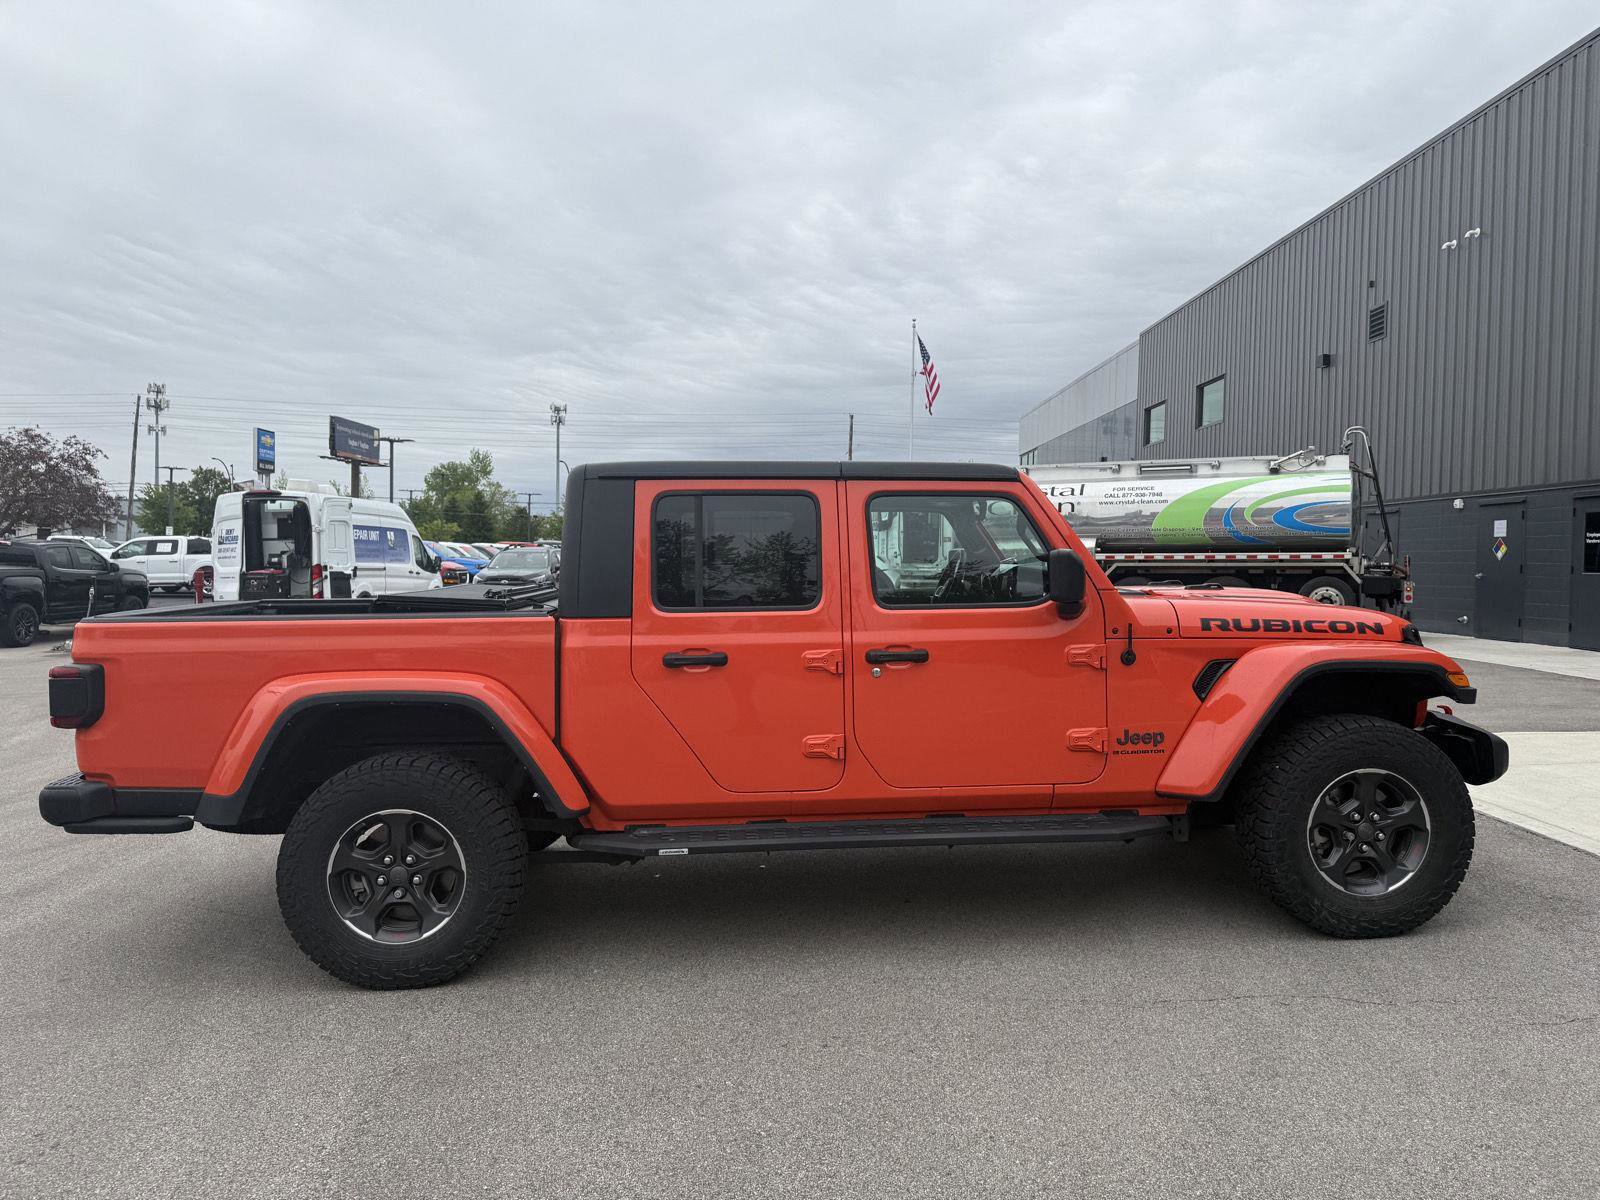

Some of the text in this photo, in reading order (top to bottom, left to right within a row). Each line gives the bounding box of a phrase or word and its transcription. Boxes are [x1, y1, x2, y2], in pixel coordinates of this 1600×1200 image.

[1098, 498, 1169, 506] www.crystal-clean.com
[369, 530, 380, 541] UNIT
[1200, 617, 1384, 635] RUBICON
[1116, 728, 1165, 747] Jeep
